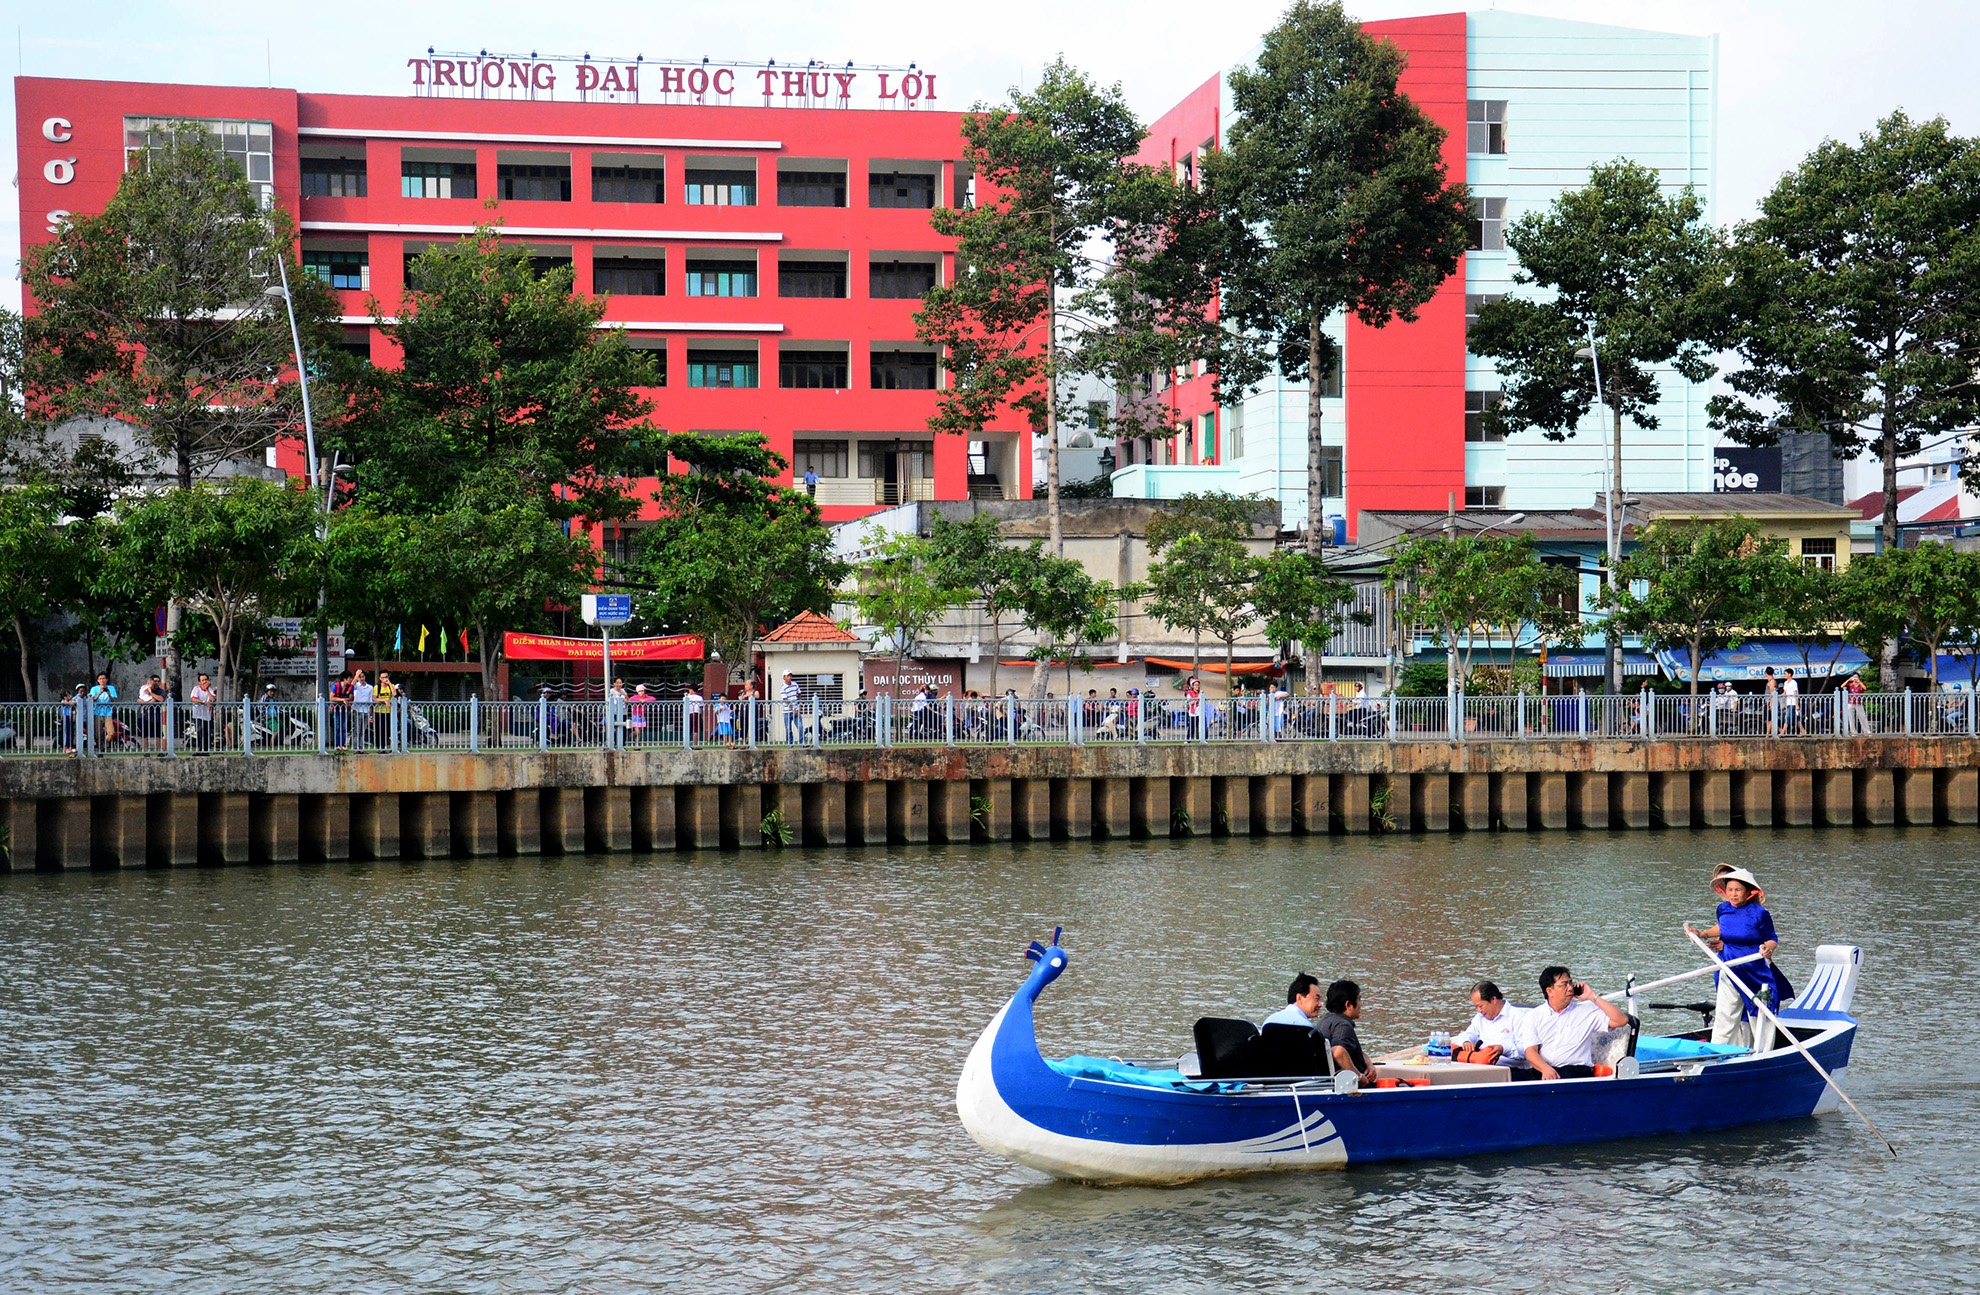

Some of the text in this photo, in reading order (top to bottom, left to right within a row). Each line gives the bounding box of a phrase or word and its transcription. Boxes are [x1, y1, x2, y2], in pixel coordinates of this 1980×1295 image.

[407, 54, 937, 107] TRƯỜNG ĐẠI HỌC THỦY LỢI
[513, 636, 536, 645] ĐIỂM
[568, 649, 583, 657] ĐẠI
[586, 649, 603, 657] HỌC
[631, 649, 645, 657] LỢI
[873, 676, 889, 686] ĐẠI
[912, 672, 937, 685] THỦY
[938, 674, 953, 686] LỢI
[1853, 948, 1860, 965] 1
